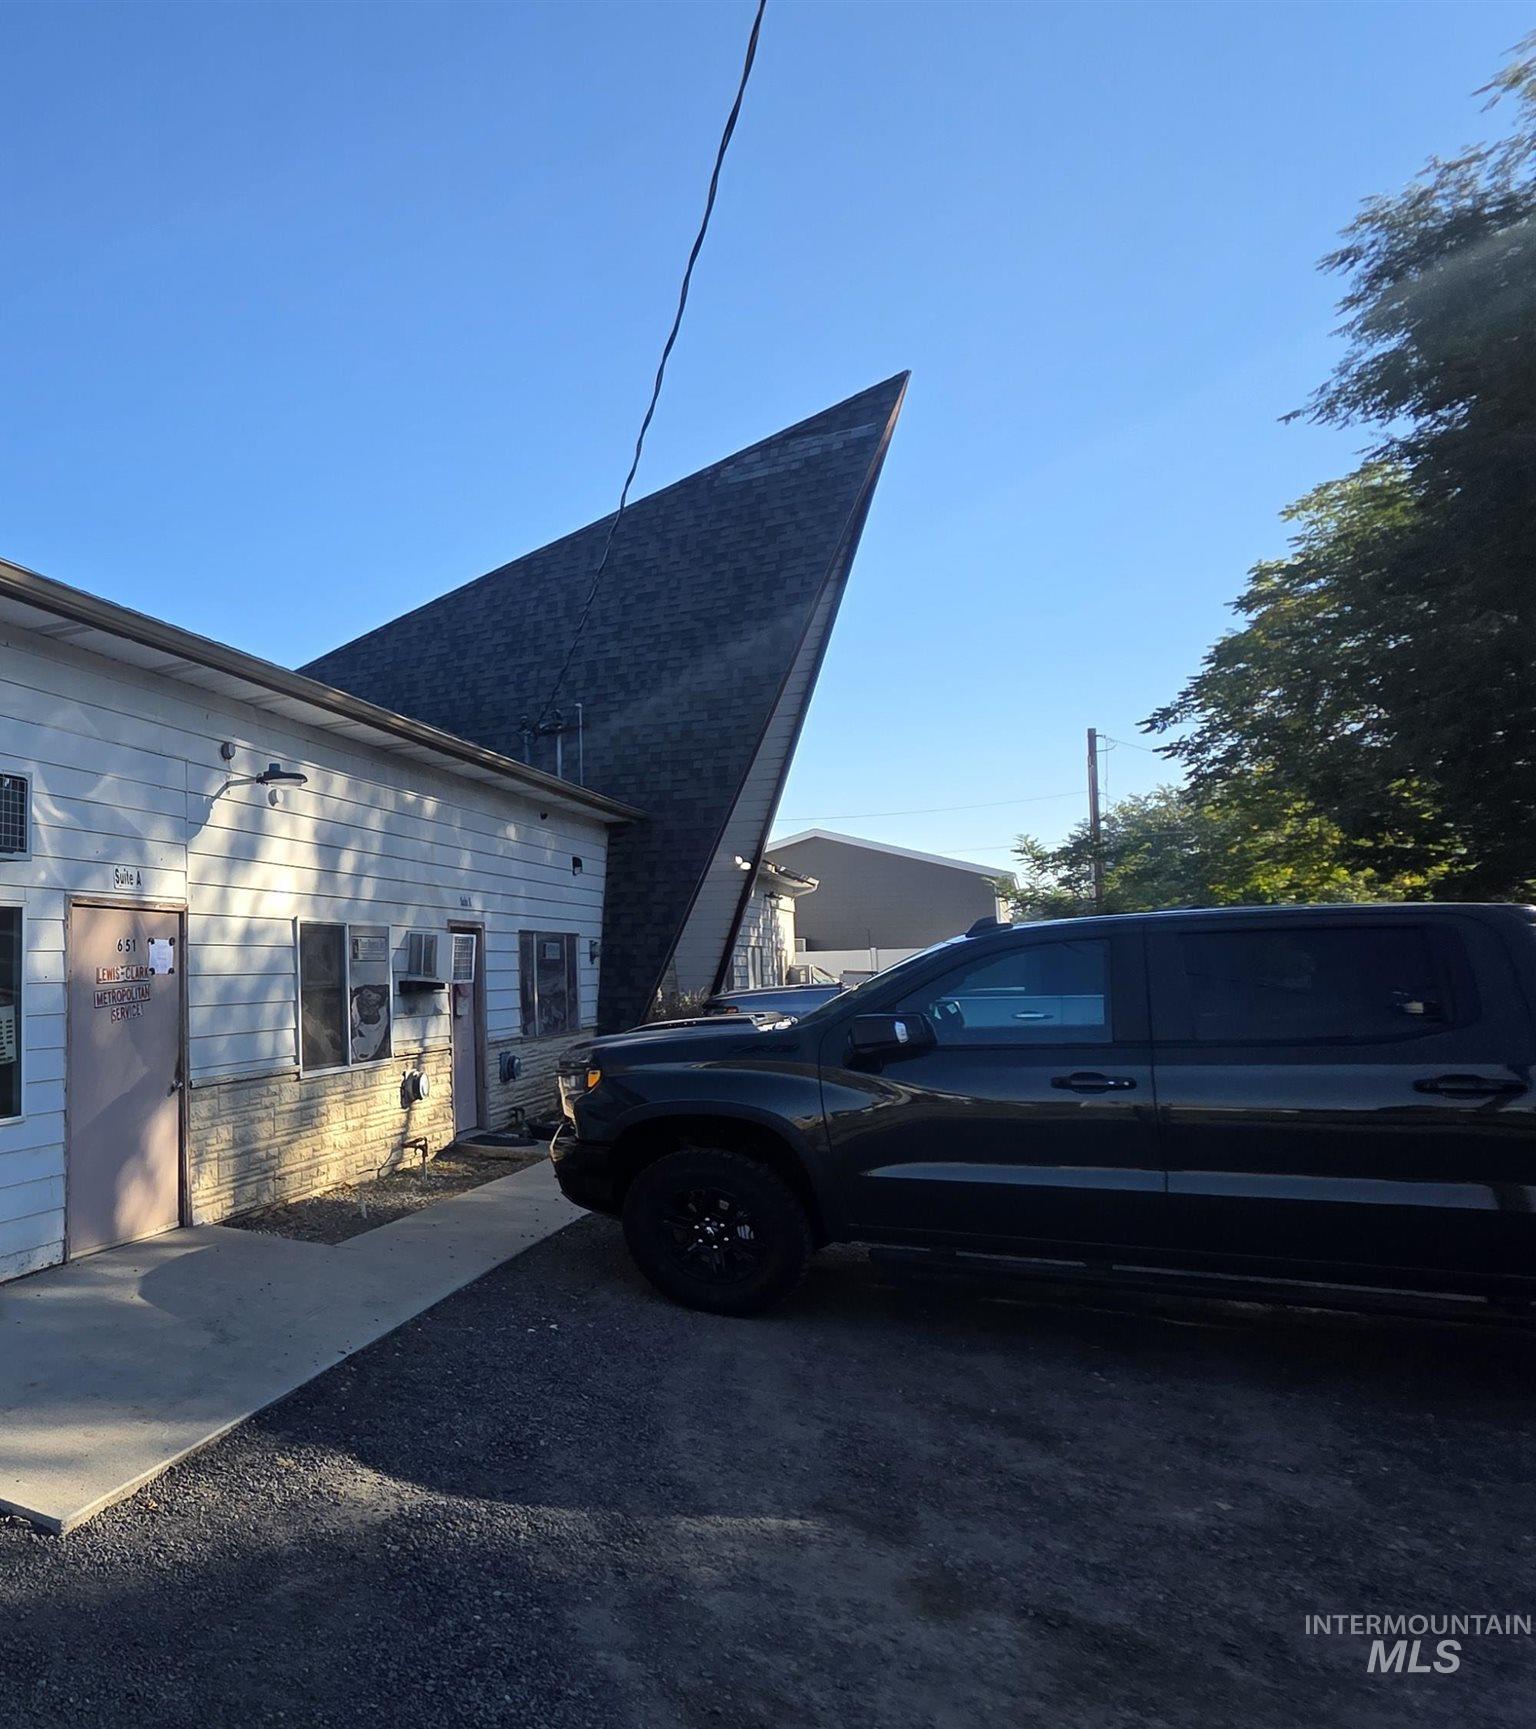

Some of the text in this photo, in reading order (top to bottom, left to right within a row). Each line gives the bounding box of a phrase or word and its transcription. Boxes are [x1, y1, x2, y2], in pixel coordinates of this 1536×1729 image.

[114, 868, 142, 886] Suite A
[117, 939, 137, 952] 651
[96, 985, 150, 1006] METROPOLITAN
